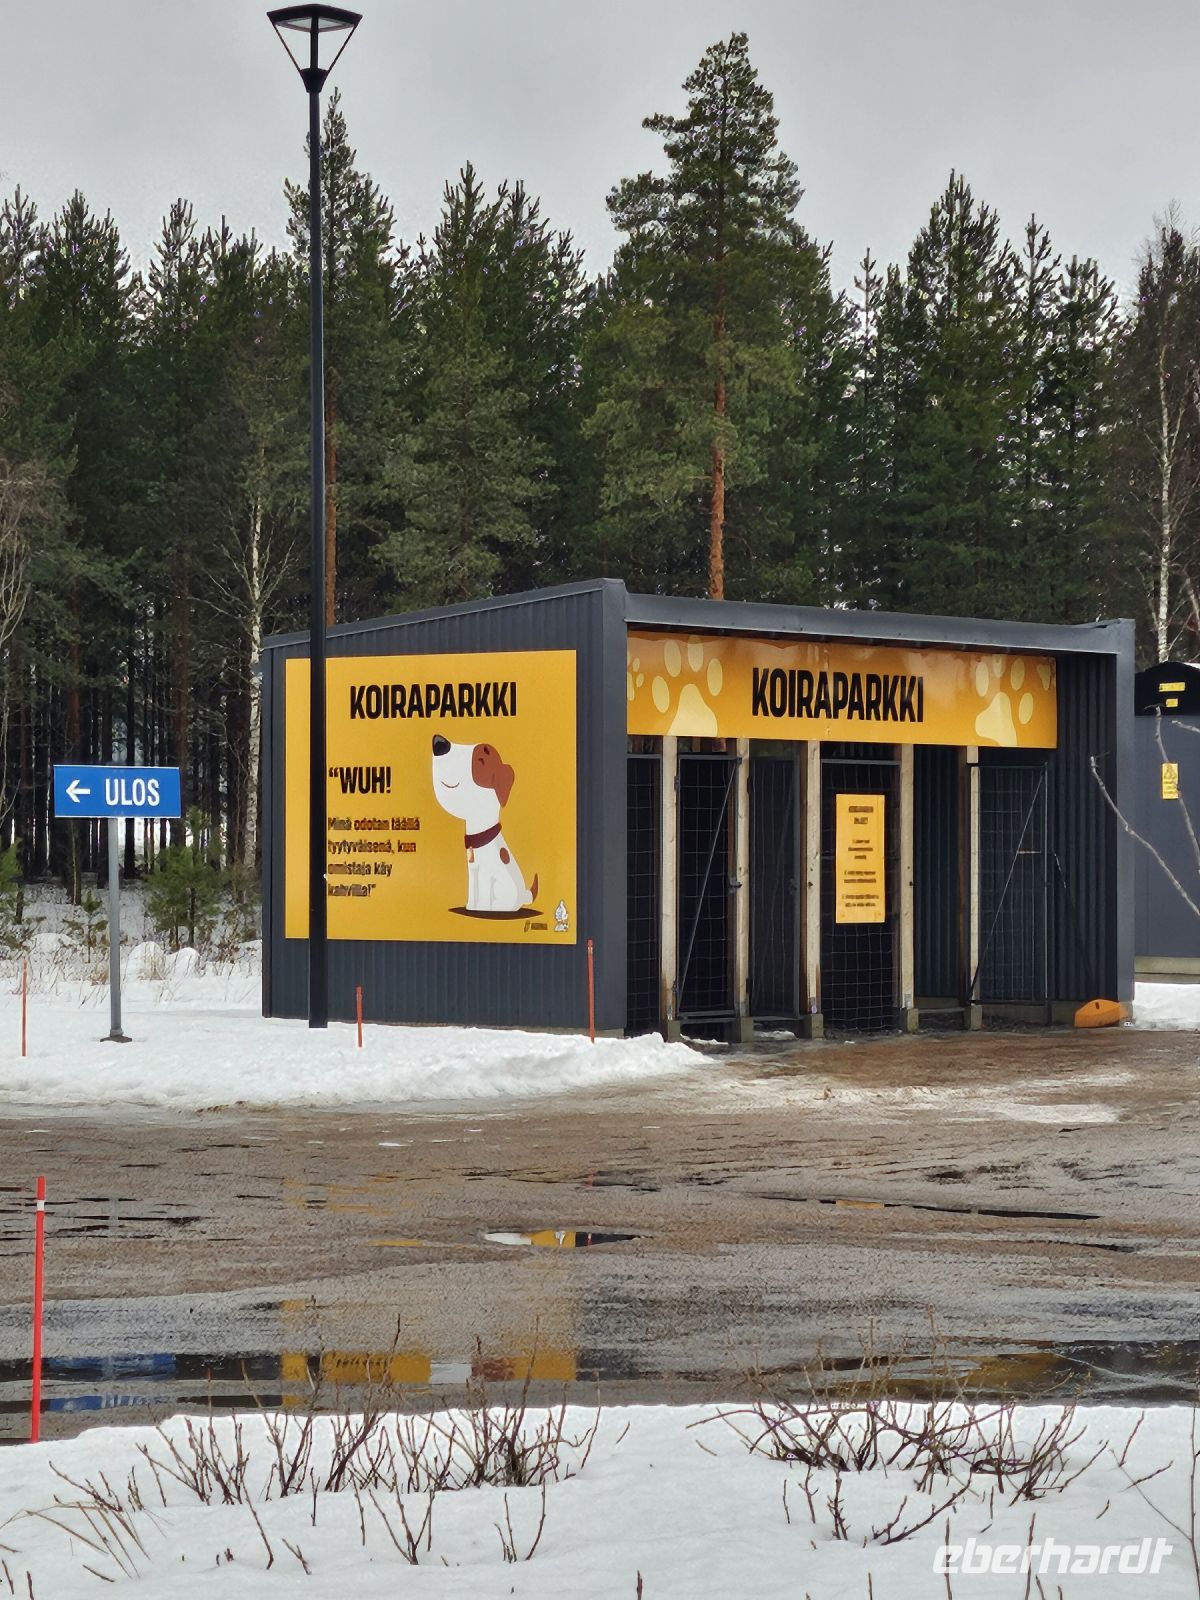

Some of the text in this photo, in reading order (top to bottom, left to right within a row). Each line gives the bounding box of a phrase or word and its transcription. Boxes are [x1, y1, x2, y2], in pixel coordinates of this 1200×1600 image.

[350, 682, 517, 719] KOIRAPARKKI
[752, 667, 924, 723] KOIRAPARKKI
[105, 778, 160, 806] ULOS
[374, 861, 393, 877] käy
